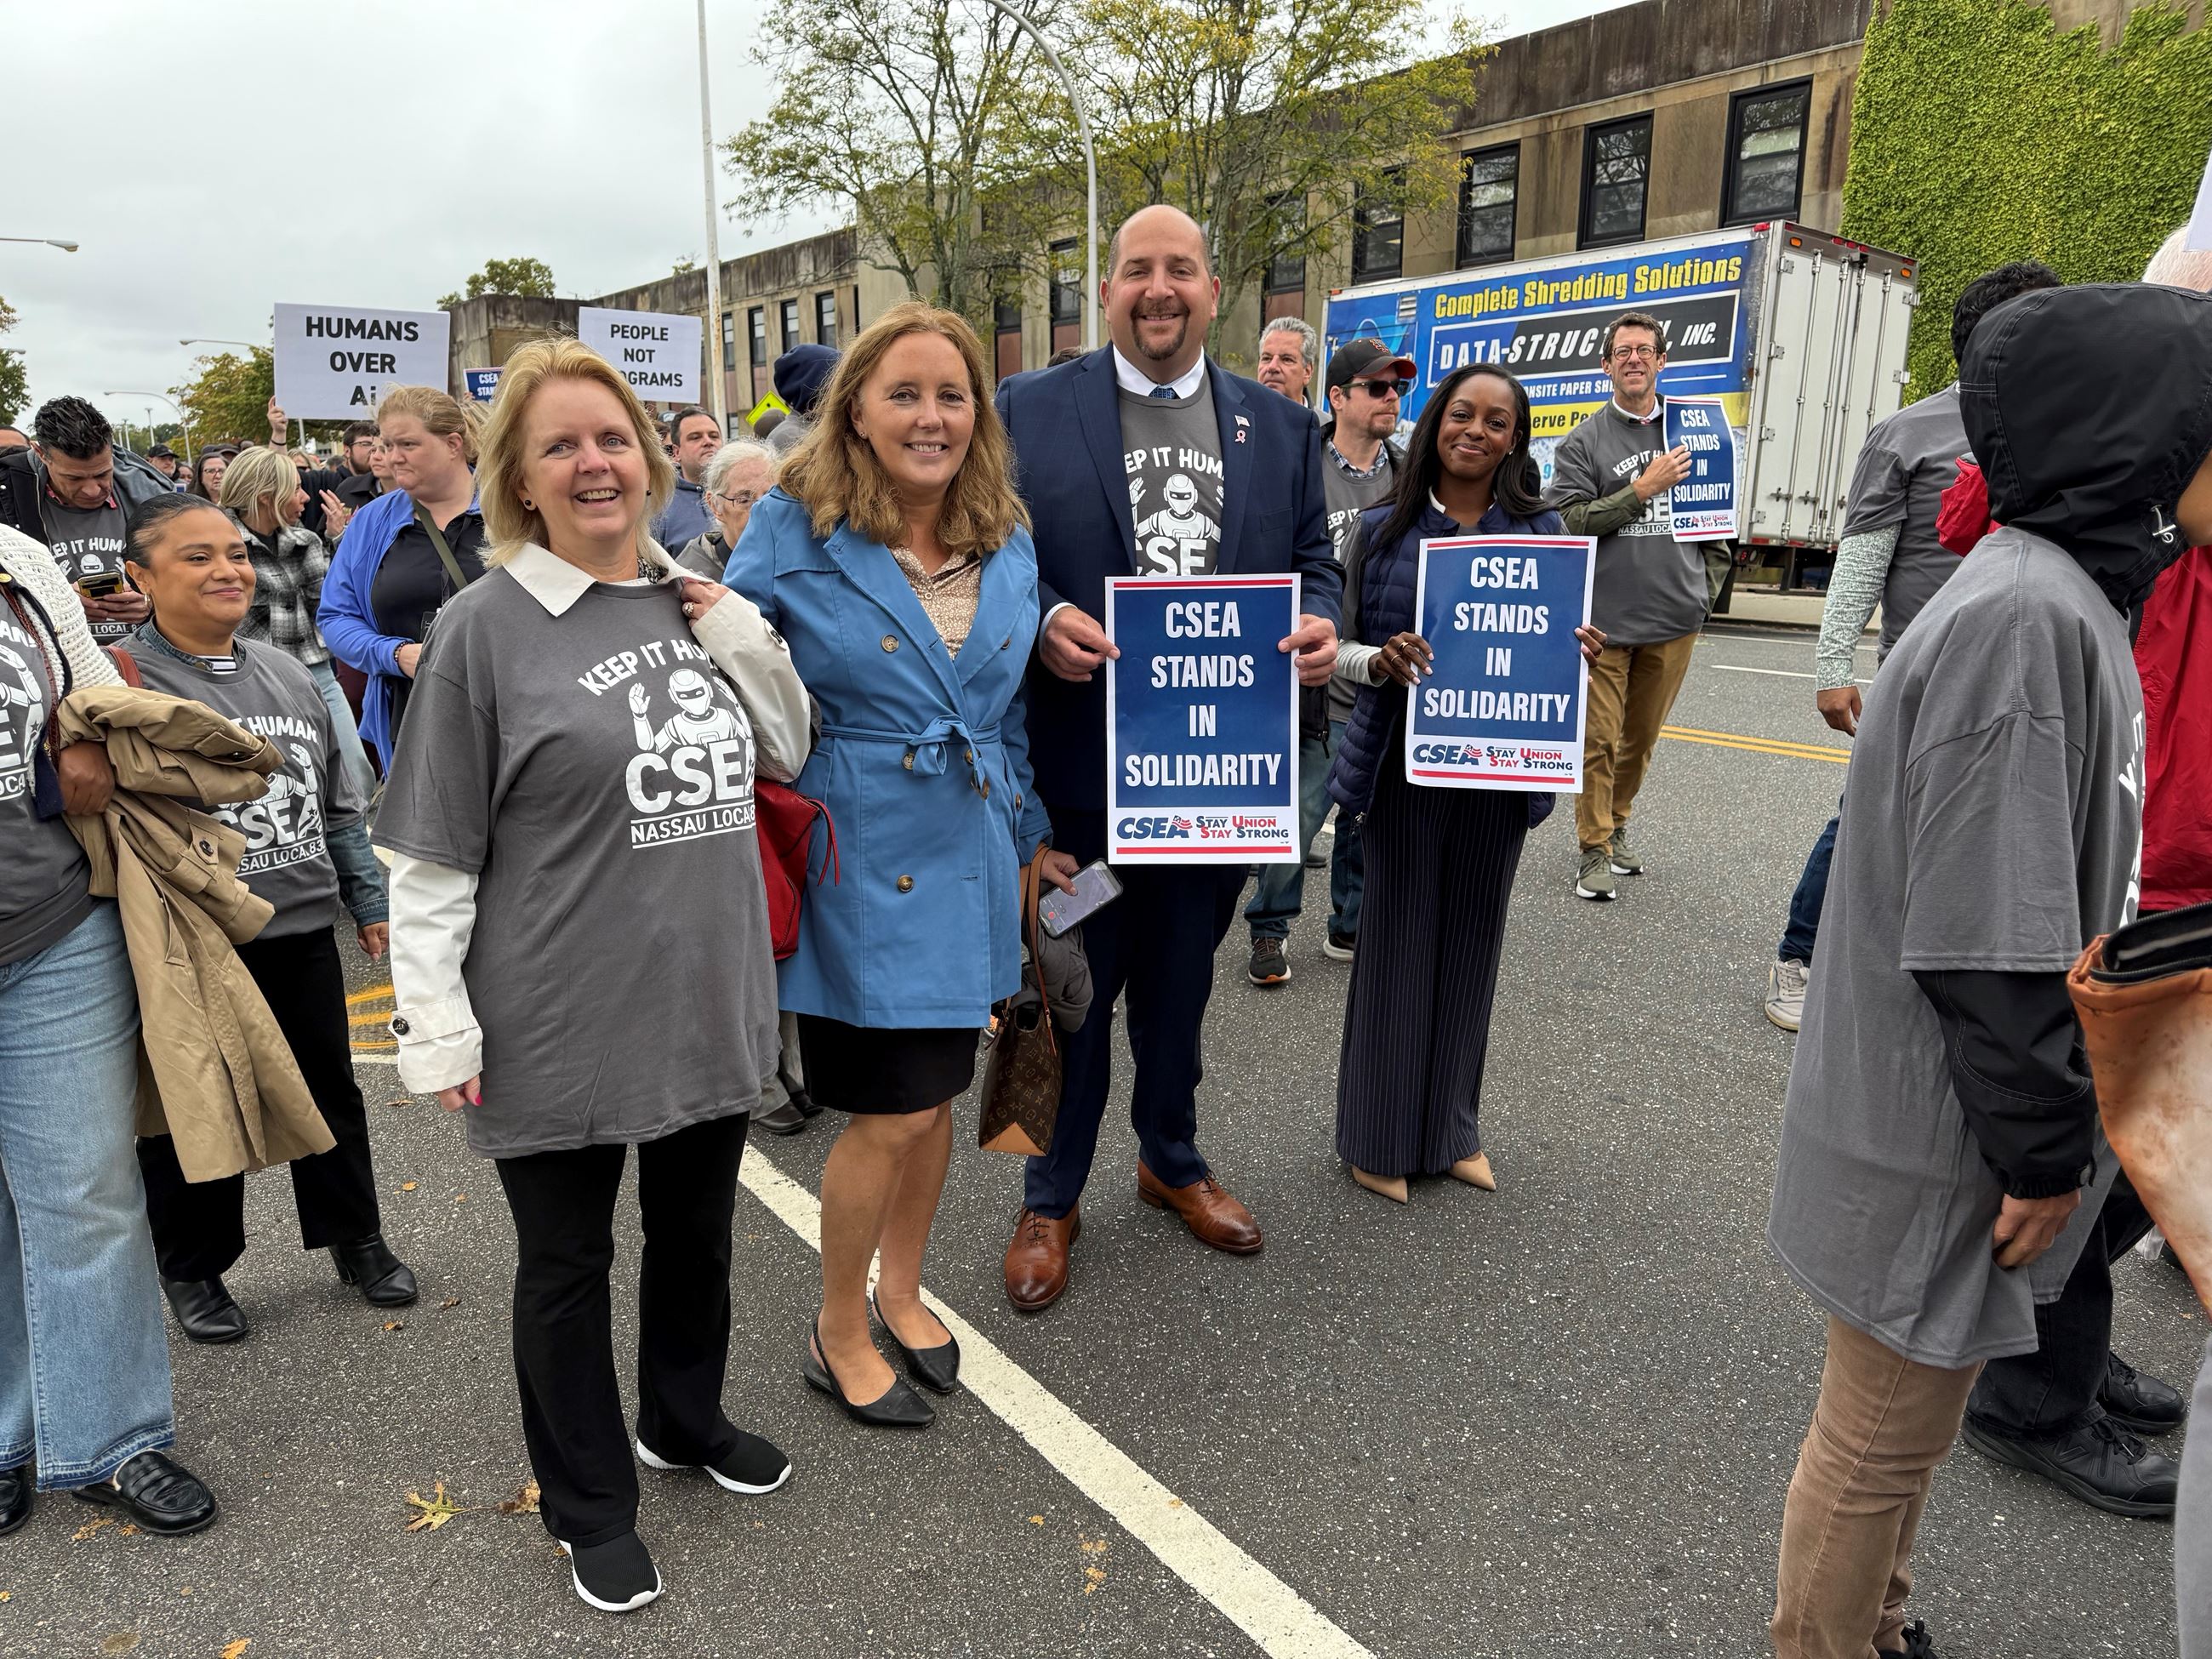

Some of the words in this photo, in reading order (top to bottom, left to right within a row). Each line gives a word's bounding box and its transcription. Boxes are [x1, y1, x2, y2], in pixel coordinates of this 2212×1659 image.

[1435, 286, 1519, 319] Complete
[1524, 272, 1628, 307] Shredding
[1633, 256, 1742, 294] Solutions
[306, 316, 419, 342] HUMANS
[611, 324, 669, 341] PEOPLE
[1680, 322, 1717, 346] INC.
[330, 351, 396, 373] OVER
[624, 348, 656, 363] NOT
[478, 373, 499, 385] CSEA
[620, 370, 683, 387] GRAMS
[1559, 380, 1592, 396] PAPER
[1532, 414, 1565, 429] erve
[1680, 409, 1711, 427] CSEA
[1680, 434, 1720, 452] STANDS
[1125, 449, 1147, 474] EP
[1152, 447, 1172, 467] IT
[1179, 448, 1225, 481] HUM
[1612, 454, 1639, 476] KEEP
[1640, 450, 1650, 463] IT
[1696, 459, 1708, 476] IN
[1673, 482, 1730, 503] SOLIDARITY
[1618, 524, 1650, 534] NASSAU
[1652, 523, 1673, 533] LOCA
[1673, 516, 1700, 528] CSEA
[71, 539, 84, 555] IT
[88, 537, 126, 553] HUM
[1470, 556, 1539, 590] CSEA
[95, 624, 129, 634] LOCAL
[1166, 601, 1241, 638] CSEA
[1454, 602, 1549, 635] STANDS
[577, 651, 639, 697] KEEP
[640, 641, 666, 669] IT
[1151, 654, 1255, 688] STANDS
[1485, 647, 1512, 677] IN
[1423, 687, 1571, 722] SOLIDARITY
[1189, 705, 1216, 737] IN
[1412, 743, 1480, 766] CSEA
[1125, 754, 1282, 787] SOLIDARITY
[630, 813, 707, 843] NASSAU
[1116, 816, 1191, 839] CSEA
